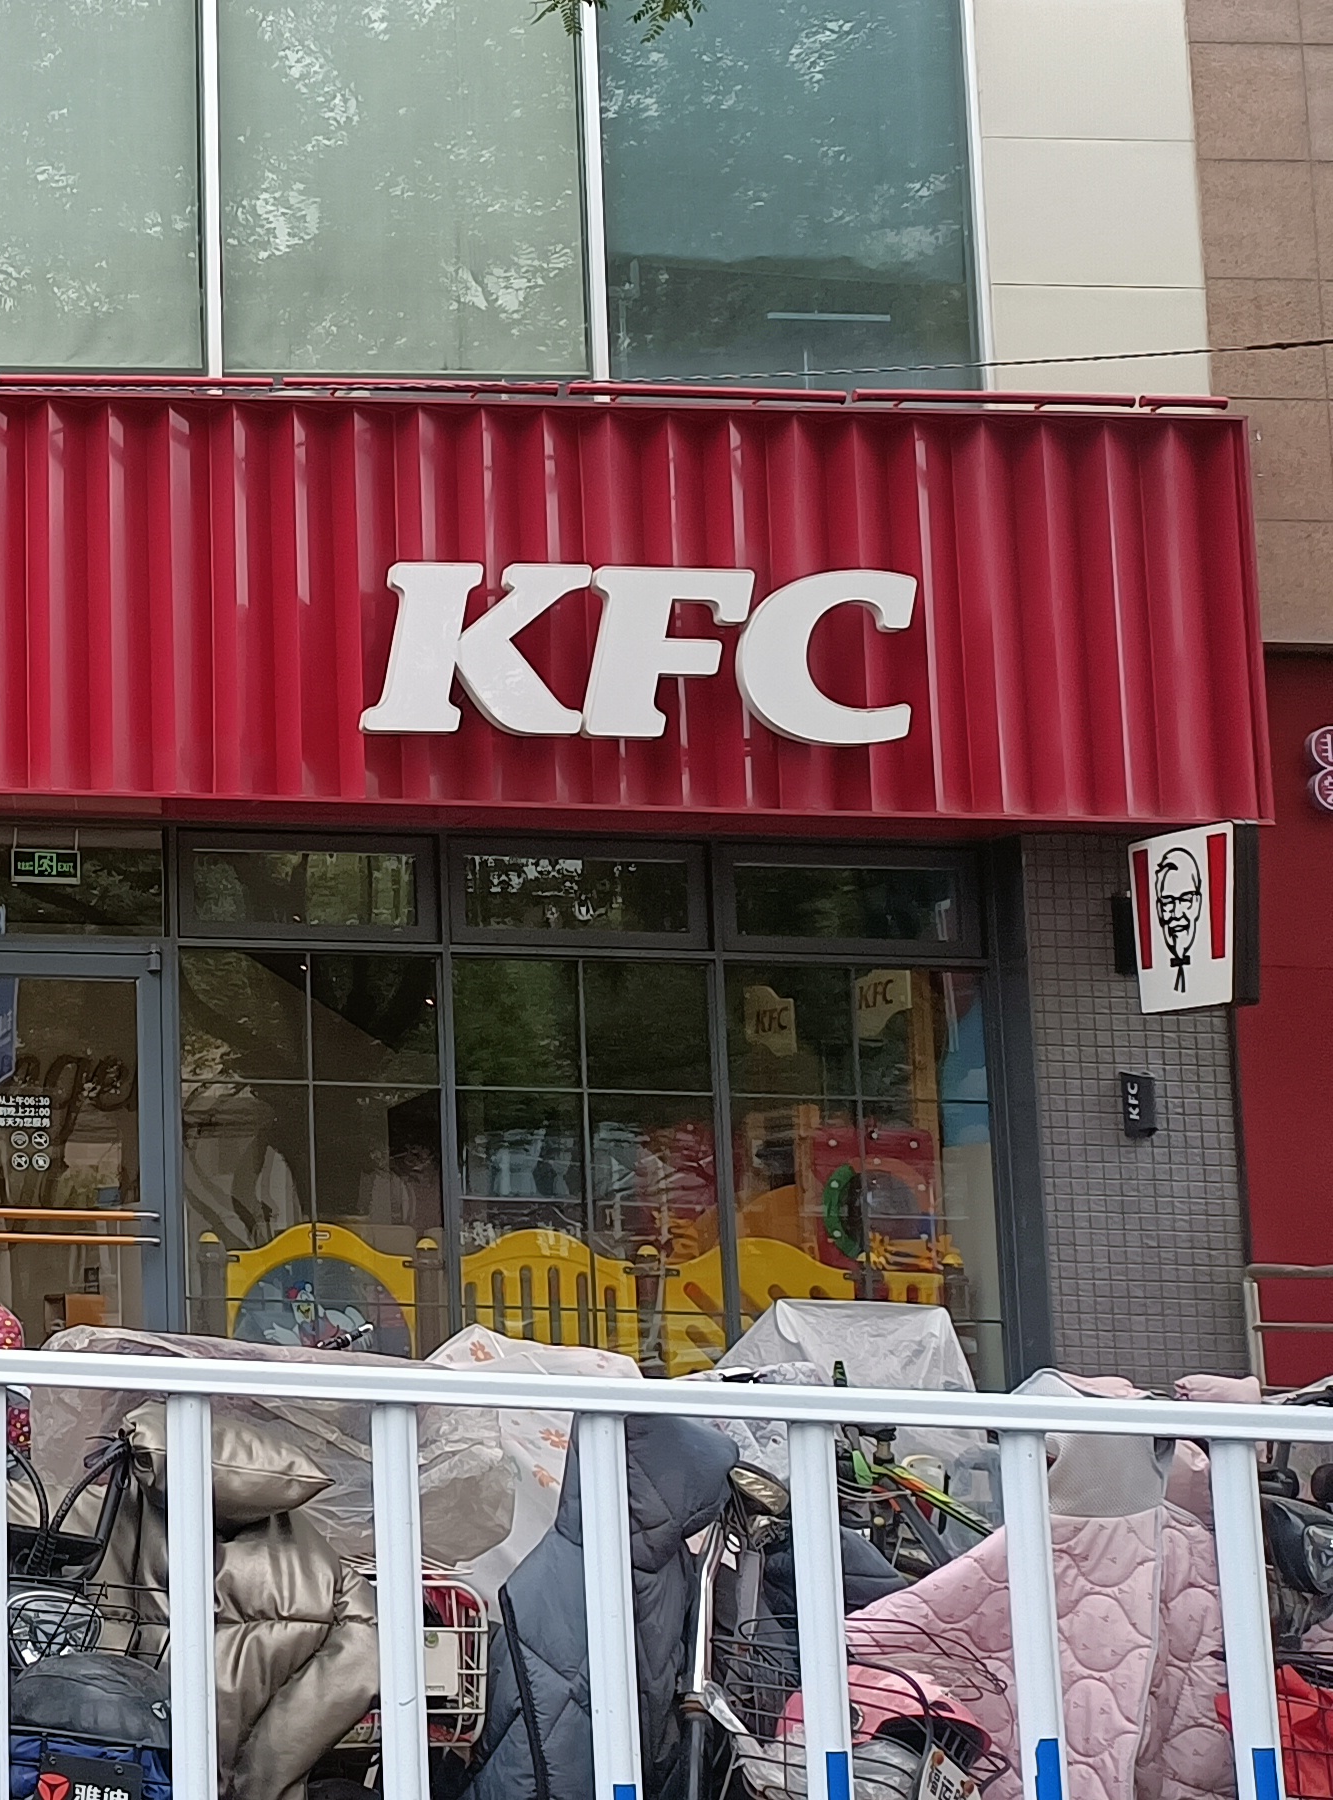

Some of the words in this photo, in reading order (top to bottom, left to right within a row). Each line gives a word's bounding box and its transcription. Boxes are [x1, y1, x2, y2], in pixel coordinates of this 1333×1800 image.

[359, 562, 917, 747] KFC
[856, 979, 894, 1010] KFC
[754, 1006, 789, 1034] KFC
[1127, 1082, 1140, 1120] KFC
